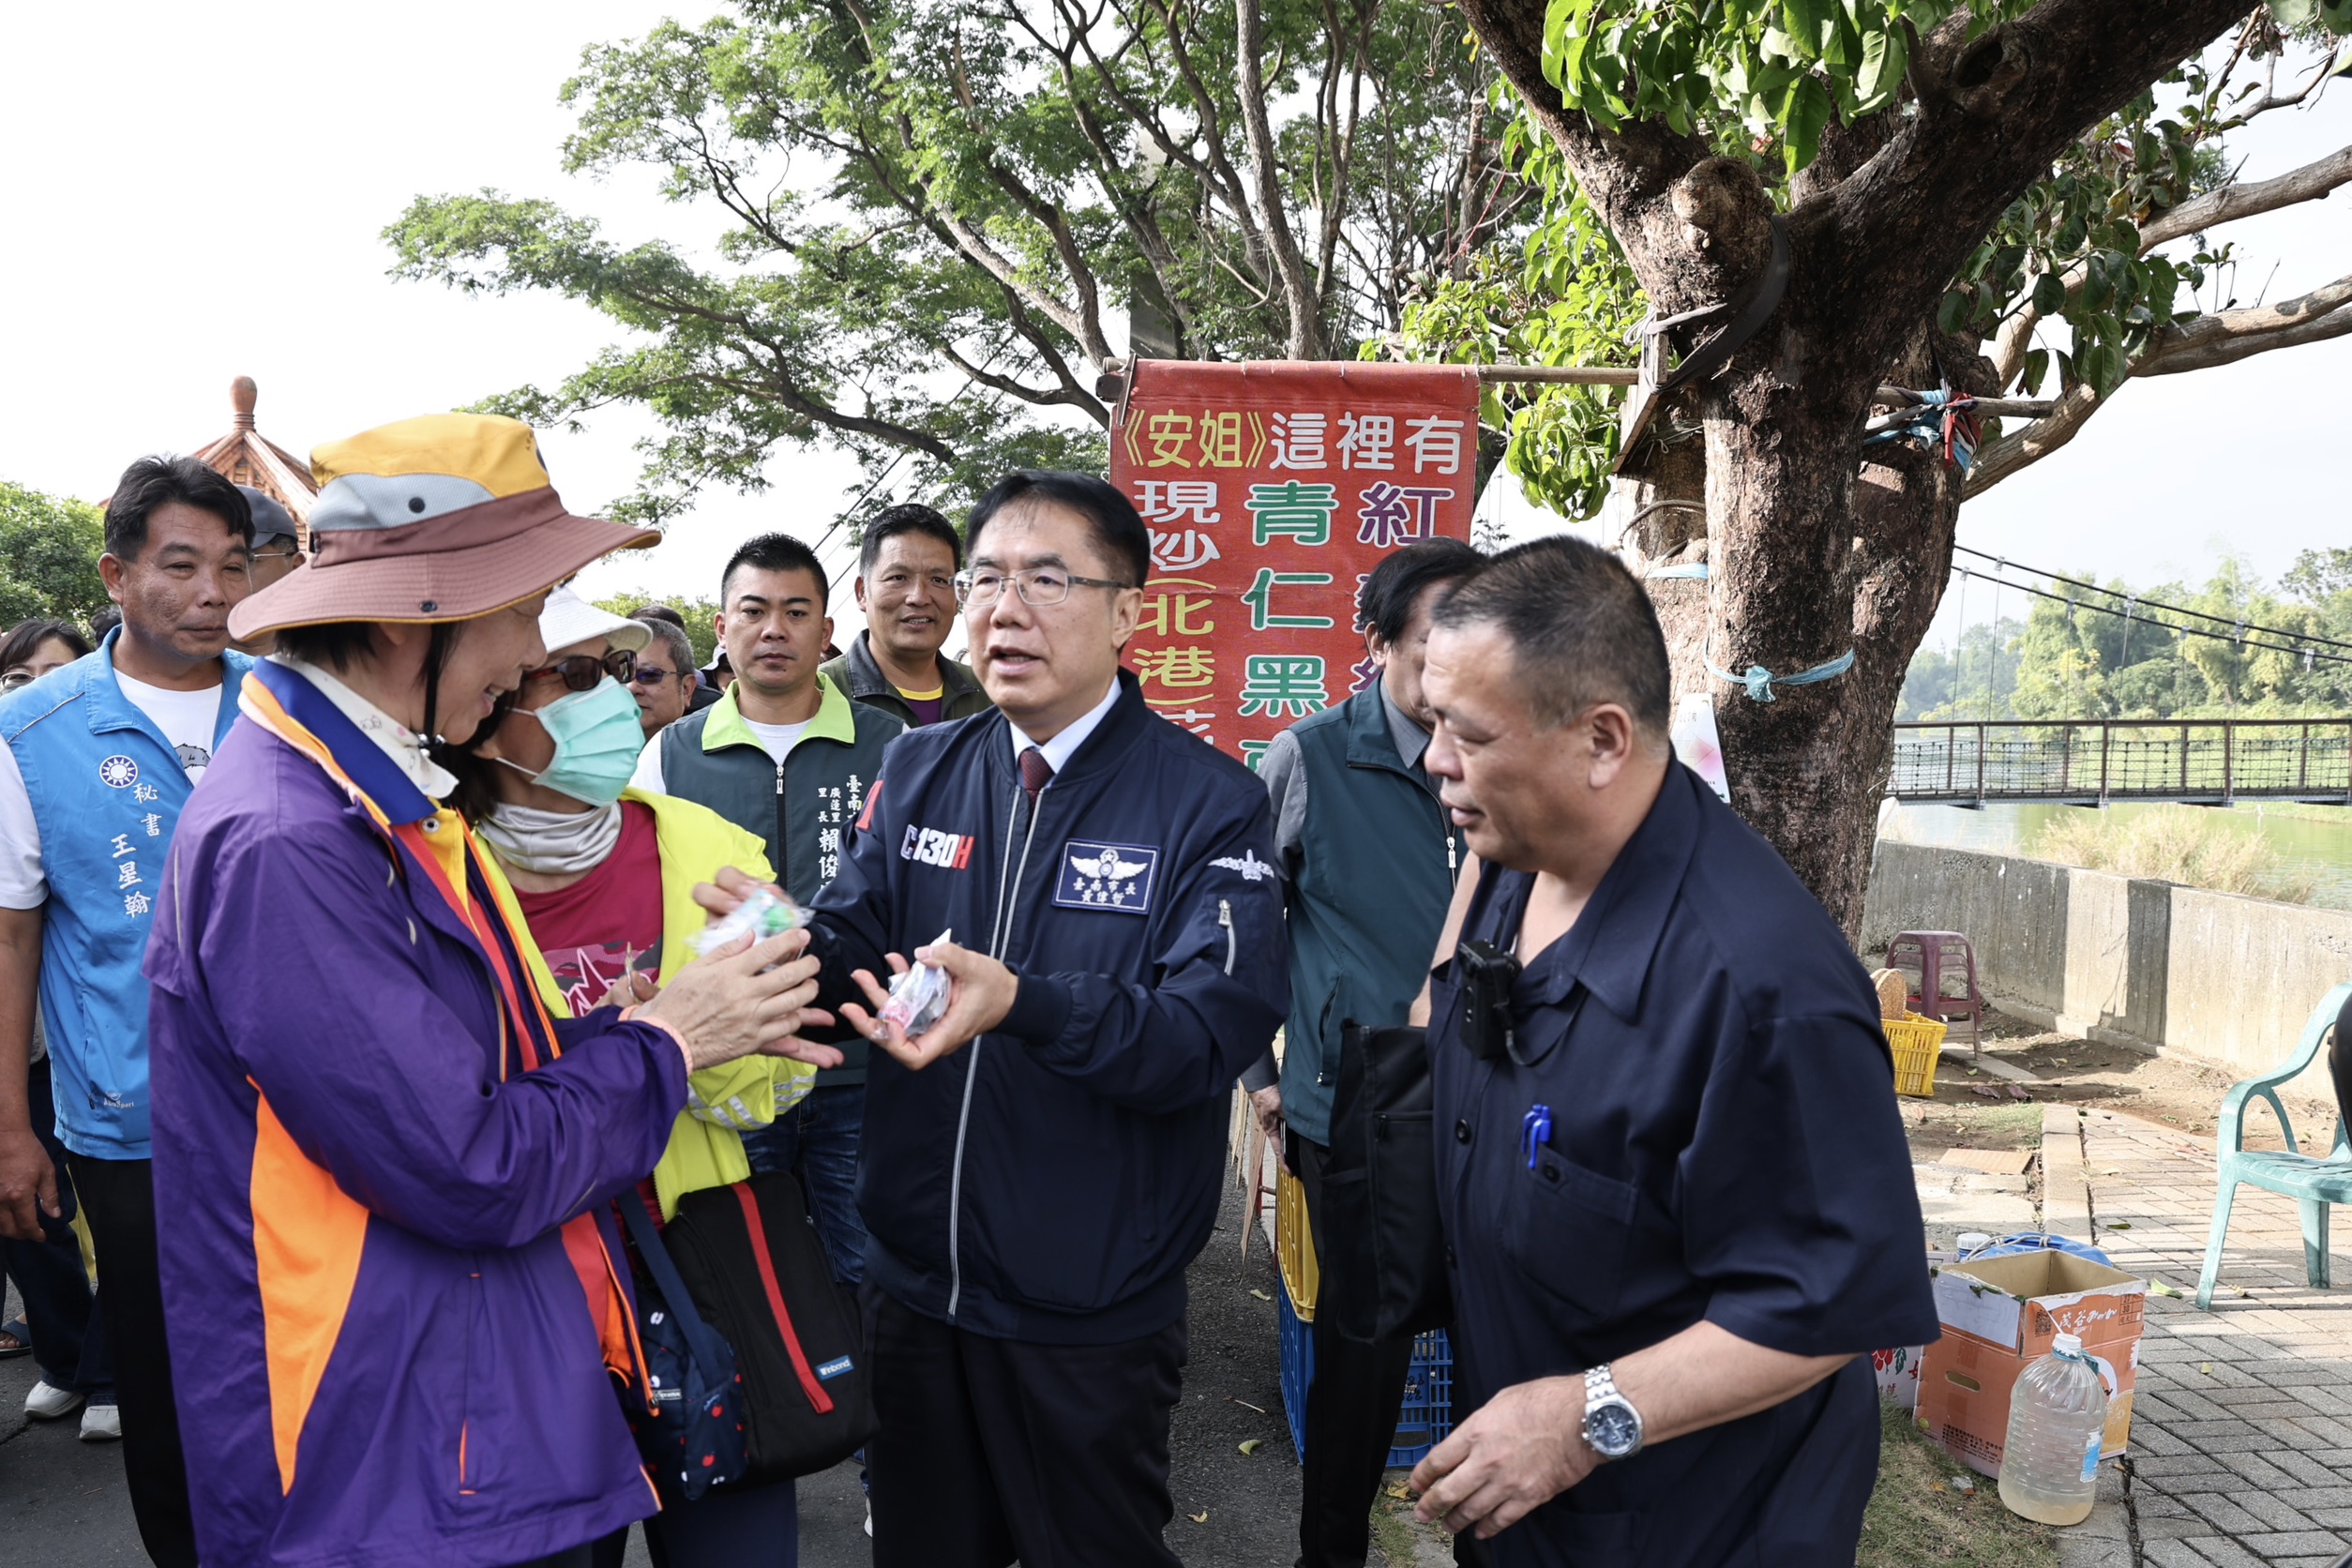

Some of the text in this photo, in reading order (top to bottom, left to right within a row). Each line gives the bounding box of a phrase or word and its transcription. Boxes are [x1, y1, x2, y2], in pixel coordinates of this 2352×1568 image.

[133, 782, 162, 837] 秘書
[110, 833, 151, 918] 王星翰
[819, 827, 839, 891] 賴俊
[900, 824, 975, 870] C130H
